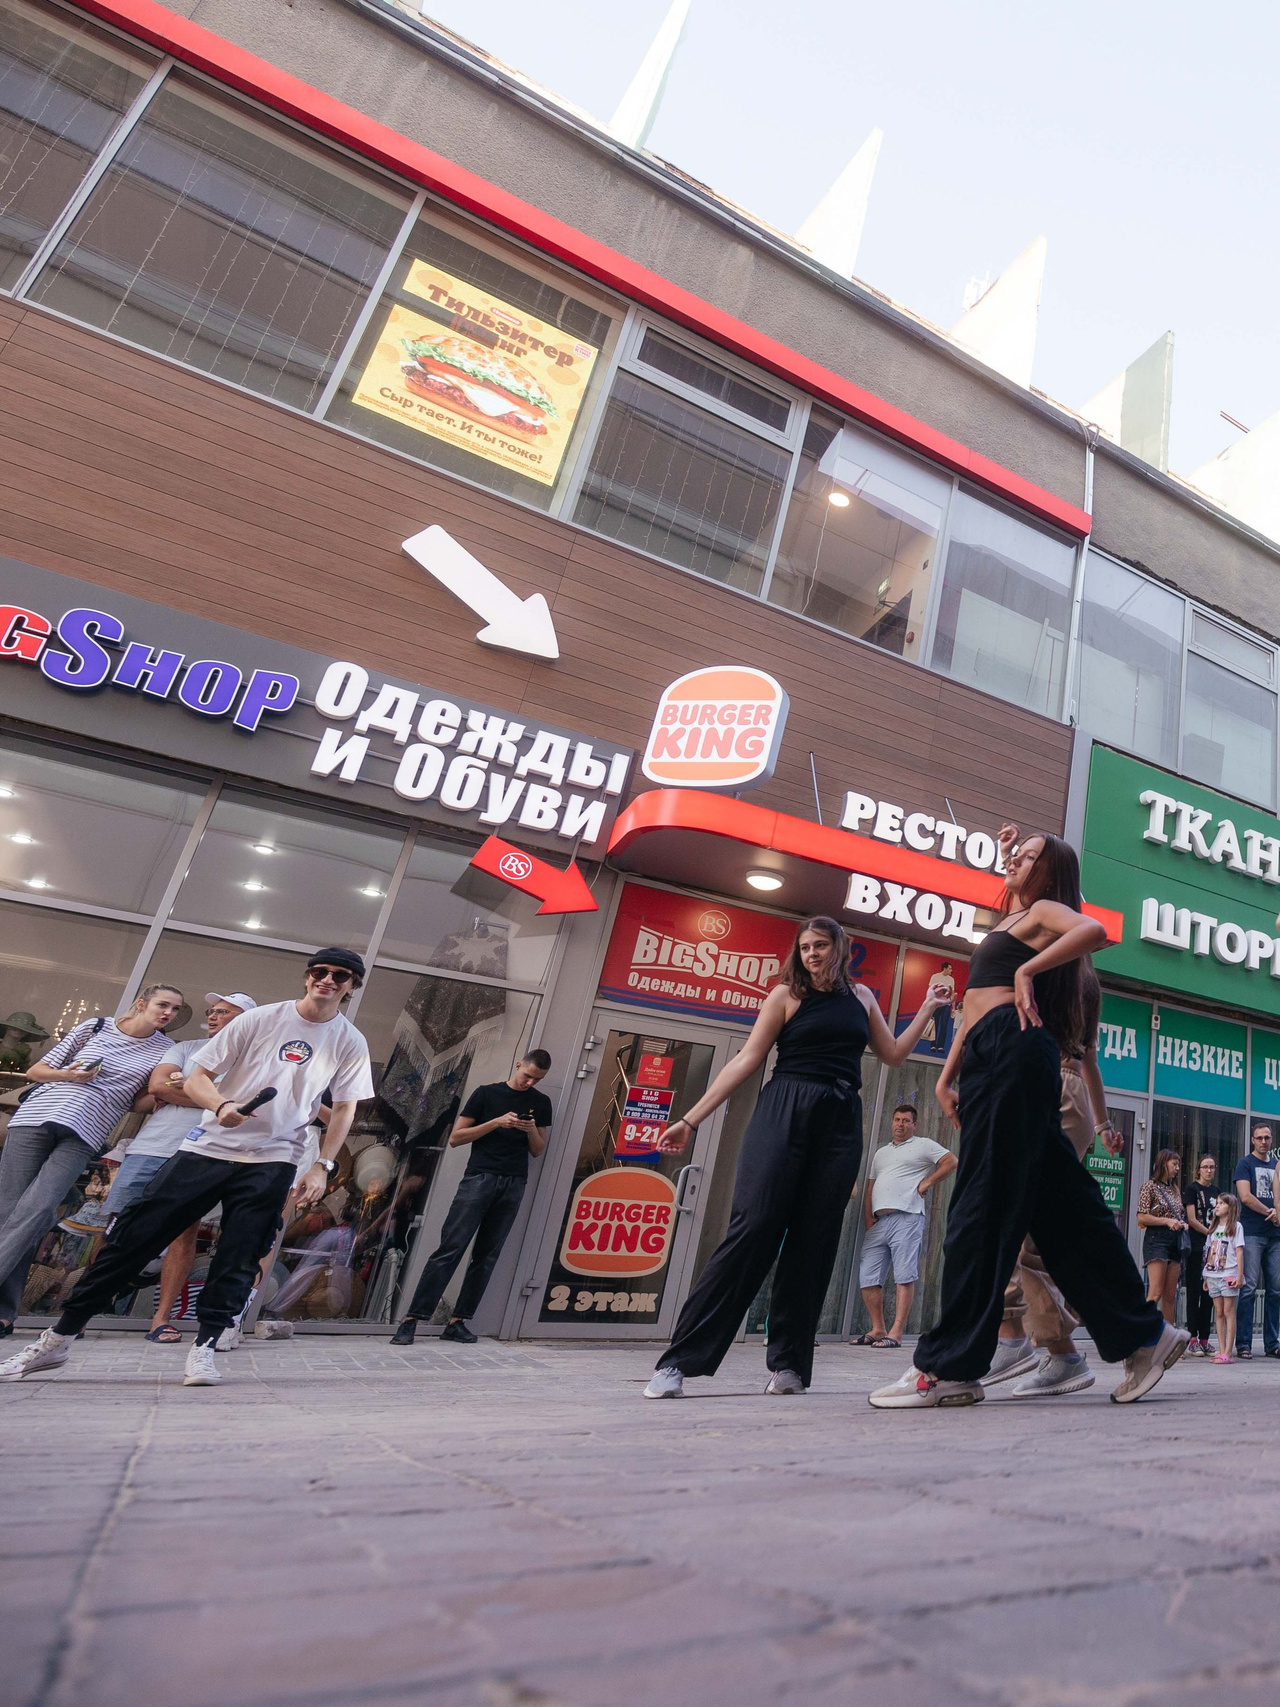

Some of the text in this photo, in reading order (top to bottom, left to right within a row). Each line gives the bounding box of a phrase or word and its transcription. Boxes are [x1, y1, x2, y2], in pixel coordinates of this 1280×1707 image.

[427, 283, 574, 368] Тильзитер
[379, 387, 543, 464] Сыр тает. И ты тоже!
[315, 661, 630, 796] Одежды
[660, 704, 773, 726] BURGER
[651, 727, 767, 759] KING
[394, 743, 608, 845] Обуви
[502, 854, 529, 878] BS
[844, 872, 977, 944] ВХОД
[703, 914, 727, 936] BS
[627, 971, 701, 999] Одежды
[1096, 1021, 1138, 1061] ГДА
[1157, 1035, 1244, 1080] НИЗКИЕ
[624, 1124, 660, 1143] 9-21
[1089, 1157, 1123, 1171] ОТКРЫТО
[575, 1200, 671, 1225] BURGER
[568, 1221, 667, 1254] KING
[547, 1285, 658, 1312] 2 этаж
